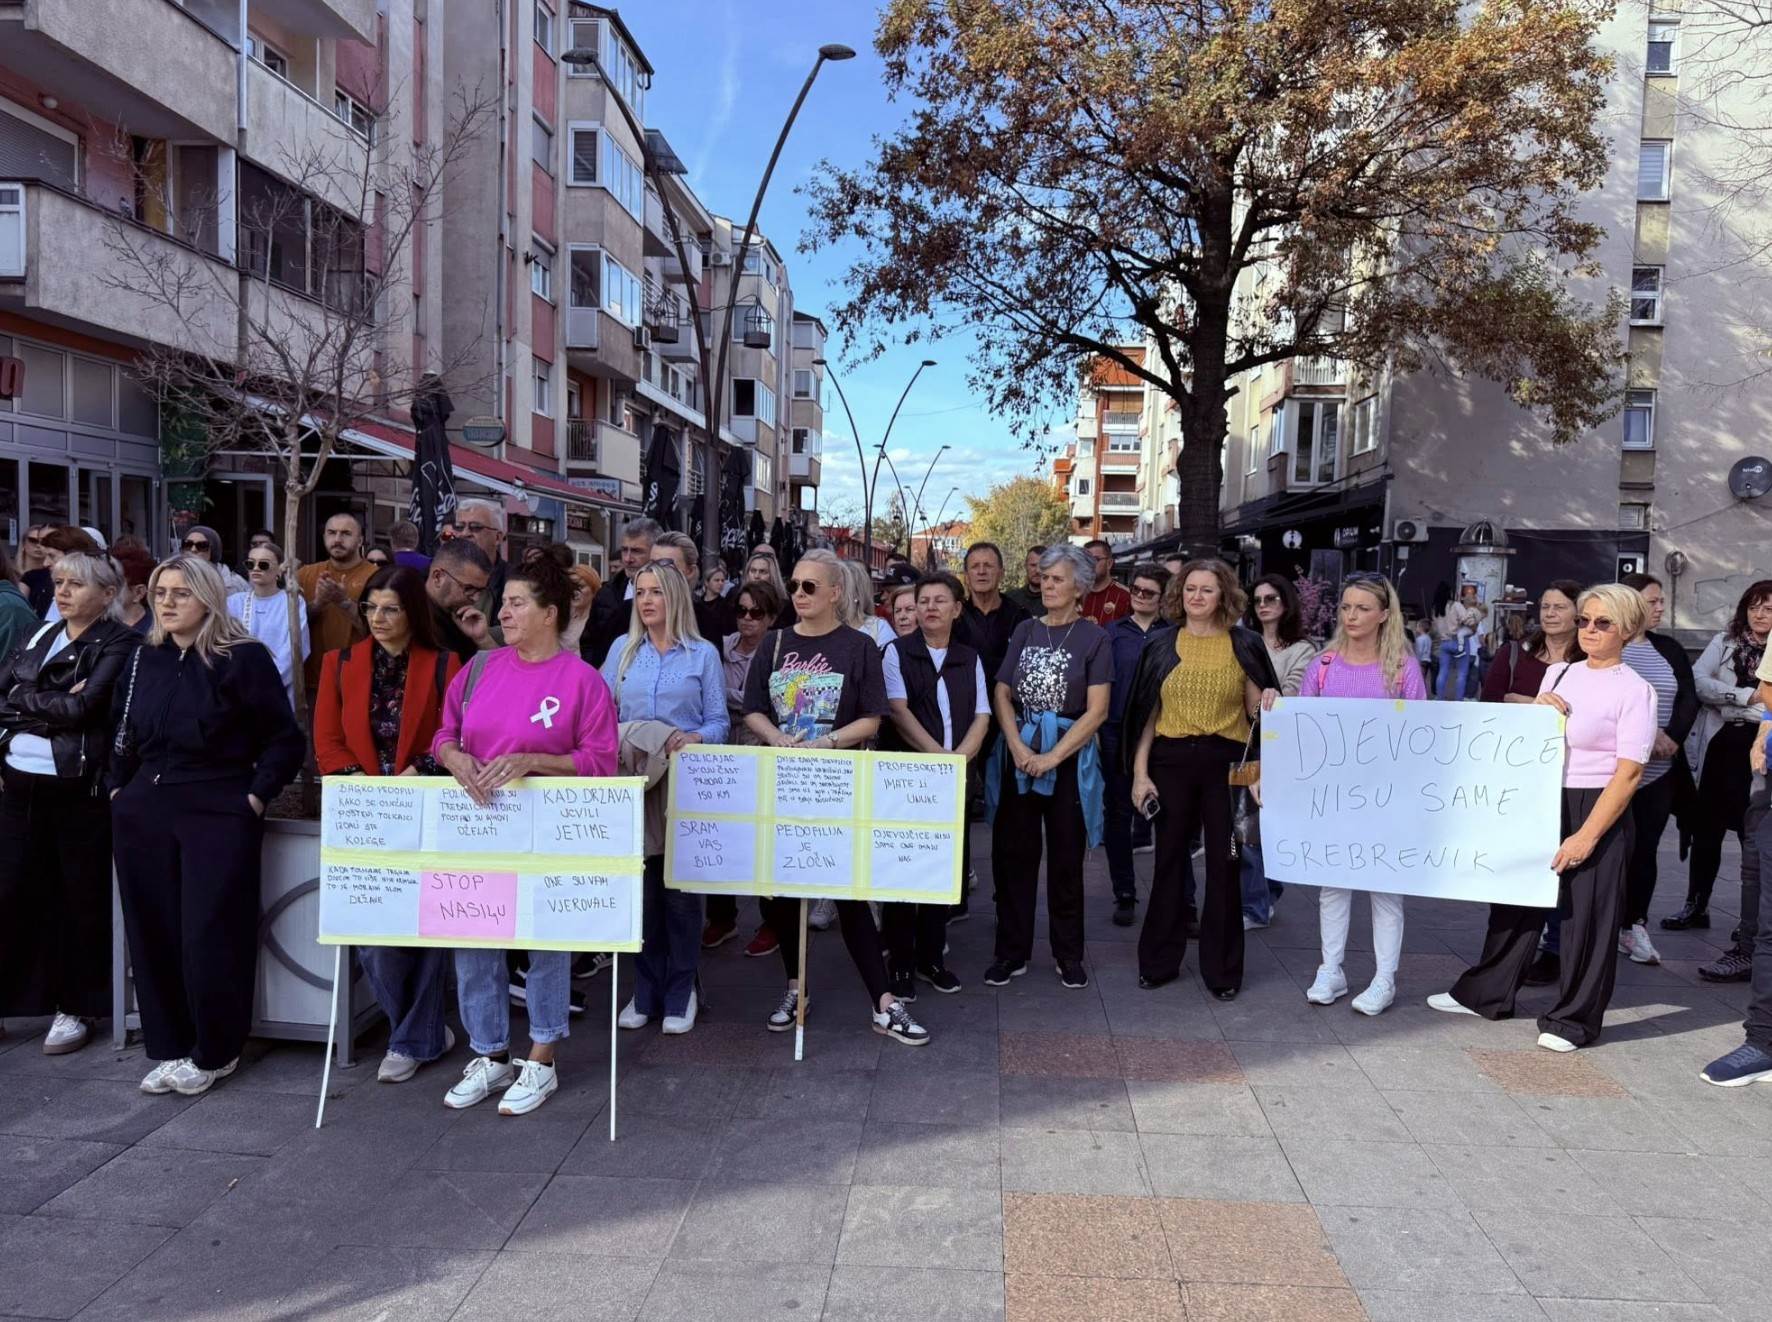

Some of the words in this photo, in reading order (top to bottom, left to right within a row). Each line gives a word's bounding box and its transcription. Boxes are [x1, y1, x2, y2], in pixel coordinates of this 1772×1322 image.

[780, 651, 833, 674] Barbie
[680, 752, 735, 763] POLICAJAC
[883, 777, 915, 790] IMATE
[543, 788, 578, 805] KAD
[697, 790, 713, 800] 150
[717, 789, 730, 799] KM
[1310, 784, 1392, 819] NISU
[1421, 782, 1519, 816] SAME
[559, 808, 599, 818] UCVILI
[555, 824, 610, 841] JETIME
[680, 821, 719, 837] SRAM
[776, 824, 844, 838] PEDOFILIJA
[345, 835, 386, 847] KOLEGE
[699, 840, 722, 851] VAS
[801, 842, 811, 852] JE
[694, 855, 723, 868] BILO
[783, 851, 836, 869] ZLOČIN
[1276, 839, 1495, 873] SREBRENIK
[431, 874, 484, 891] STOP
[544, 875, 563, 889] ONE
[572, 875, 588, 886] SU
[547, 897, 617, 913] VJEROVALE
